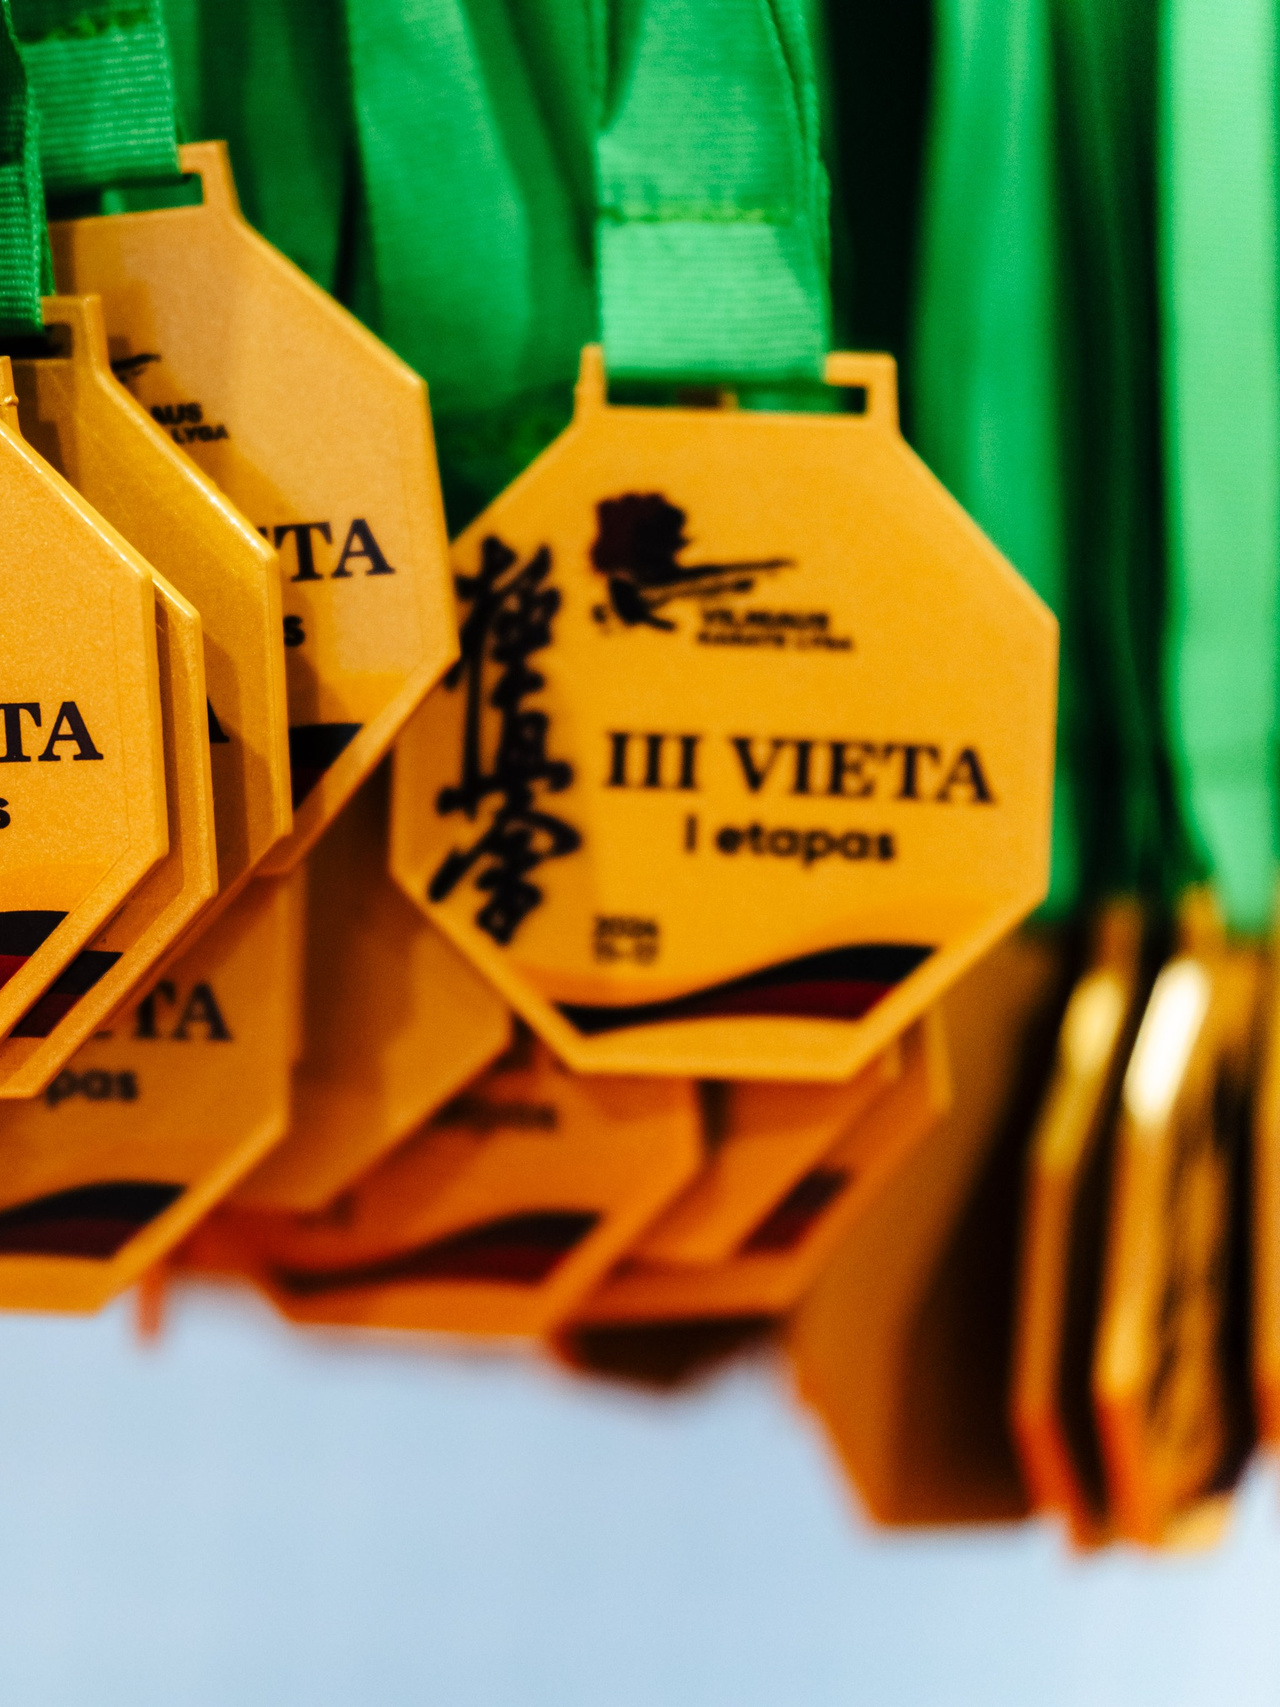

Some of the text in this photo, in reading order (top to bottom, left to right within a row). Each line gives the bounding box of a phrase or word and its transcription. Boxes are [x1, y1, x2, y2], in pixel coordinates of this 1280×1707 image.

[606, 730, 995, 804] III VIETA
[715, 822, 897, 869] etapas
